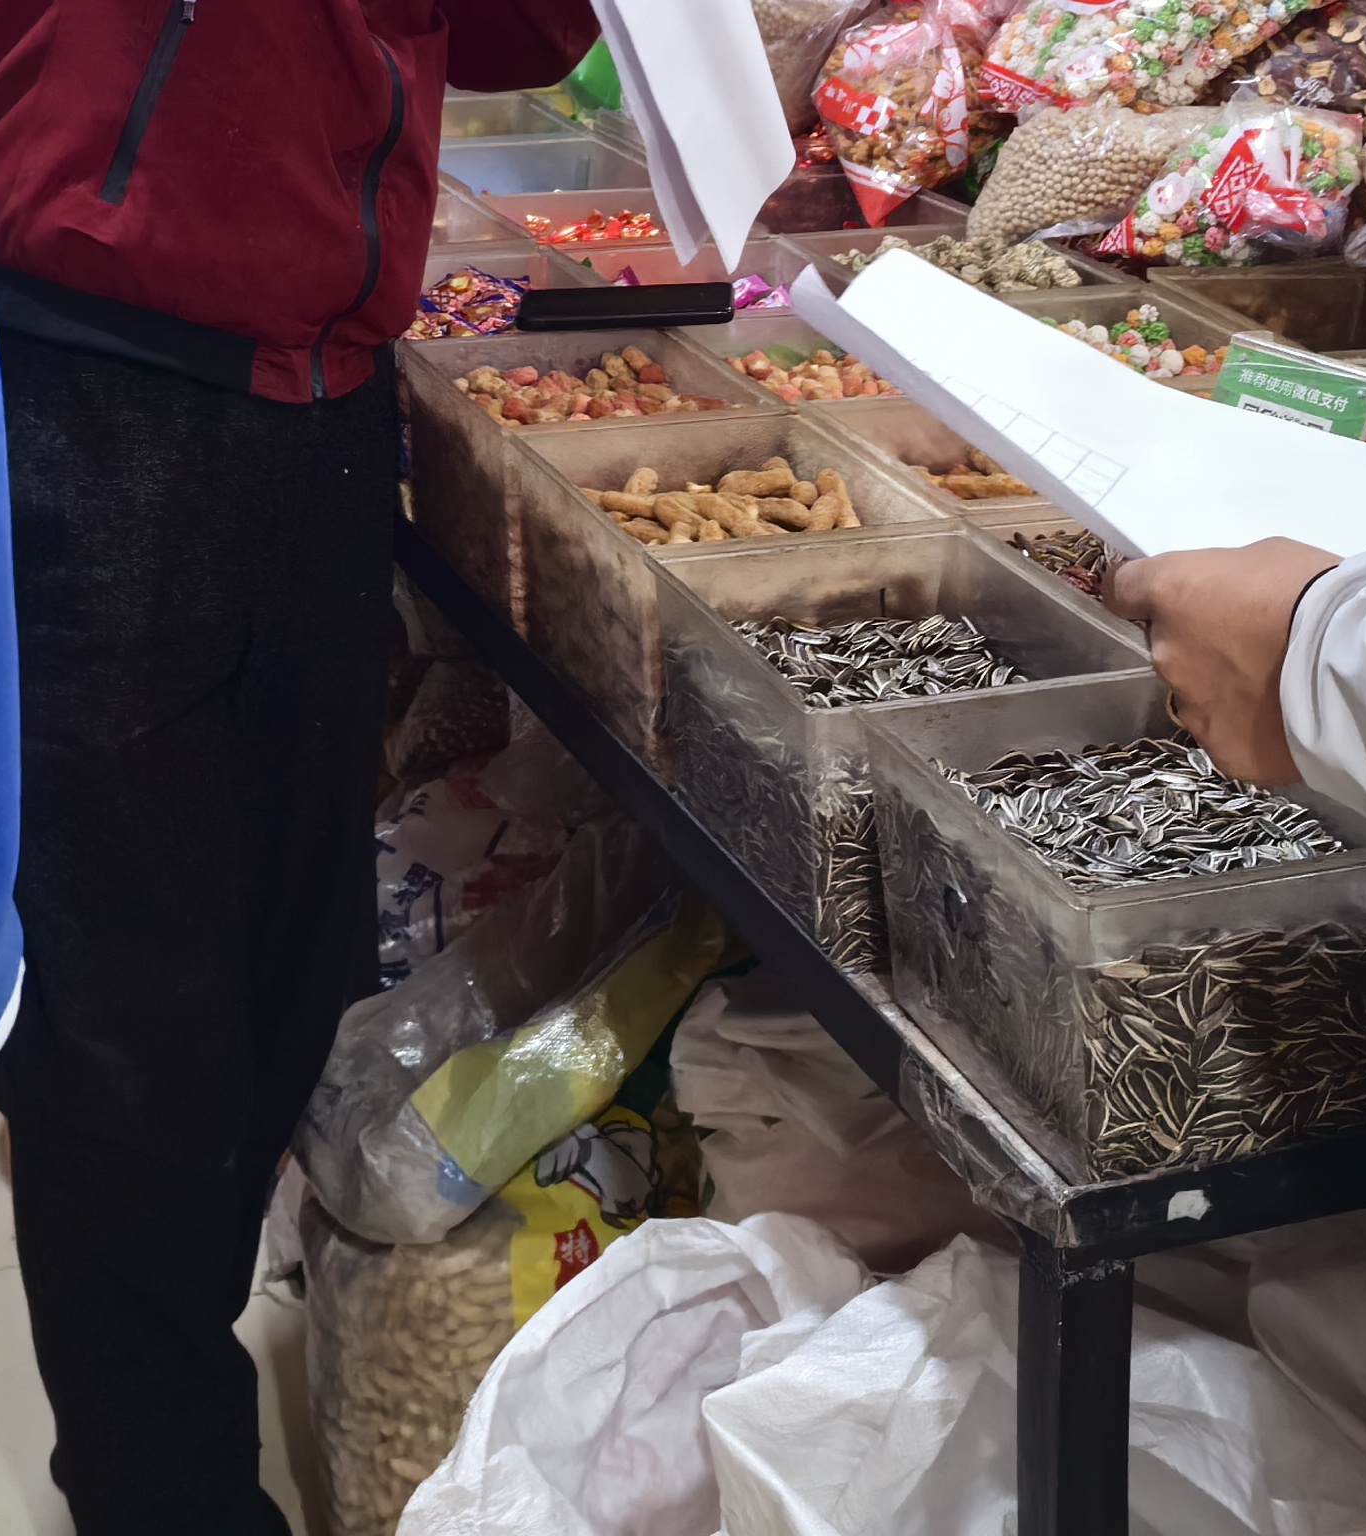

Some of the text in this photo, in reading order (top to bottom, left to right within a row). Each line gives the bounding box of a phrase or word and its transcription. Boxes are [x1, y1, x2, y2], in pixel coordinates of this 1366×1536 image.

[1239, 368, 1349, 414] 推荐使用微信支付
